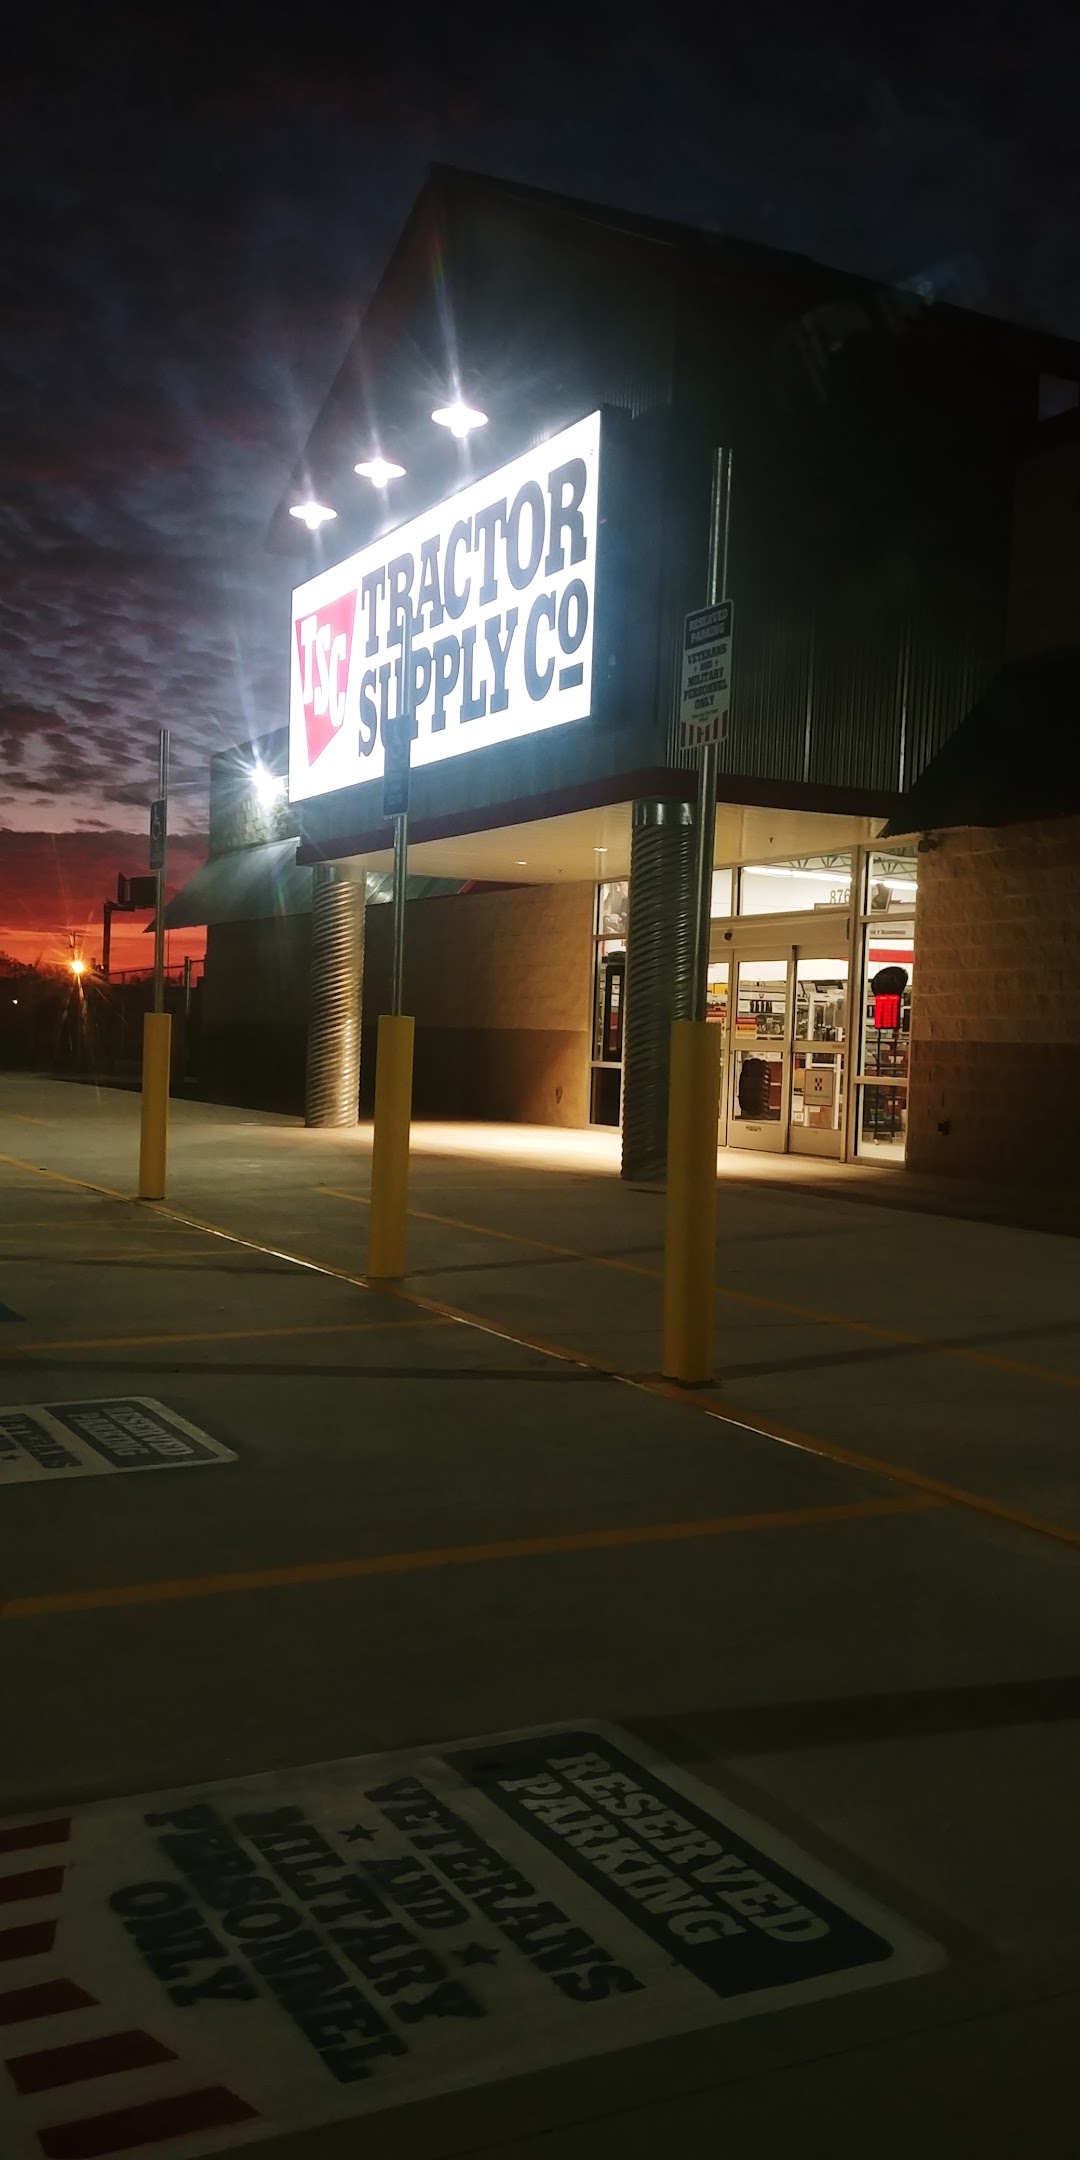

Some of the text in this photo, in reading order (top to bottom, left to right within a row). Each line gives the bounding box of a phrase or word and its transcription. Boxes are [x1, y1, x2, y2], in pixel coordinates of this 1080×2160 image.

[361, 458, 587, 658] TRACTOR
[300, 614, 348, 728] TSC
[688, 643, 727, 665] VETERANS
[688, 666, 724, 687] MILITARY
[689, 609, 728, 631] RESERVED
[691, 622, 724, 643] PARKING
[700, 660, 712, 671] AND
[358, 607, 518, 757] SUPPLY
[684, 679, 727, 701] PERSONNEL
[695, 694, 715, 709] ONLY
[360, 1856, 470, 1929] AND
[364, 1776, 646, 2001] VETERANS
[497, 1773, 747, 1945] PARKING
[546, 1752, 831, 1943] RESERVED
[109, 1881, 259, 2007] ONLY
[144, 1805, 409, 2084] PERSONNEL
[233, 1806, 487, 2024] MILITARY
